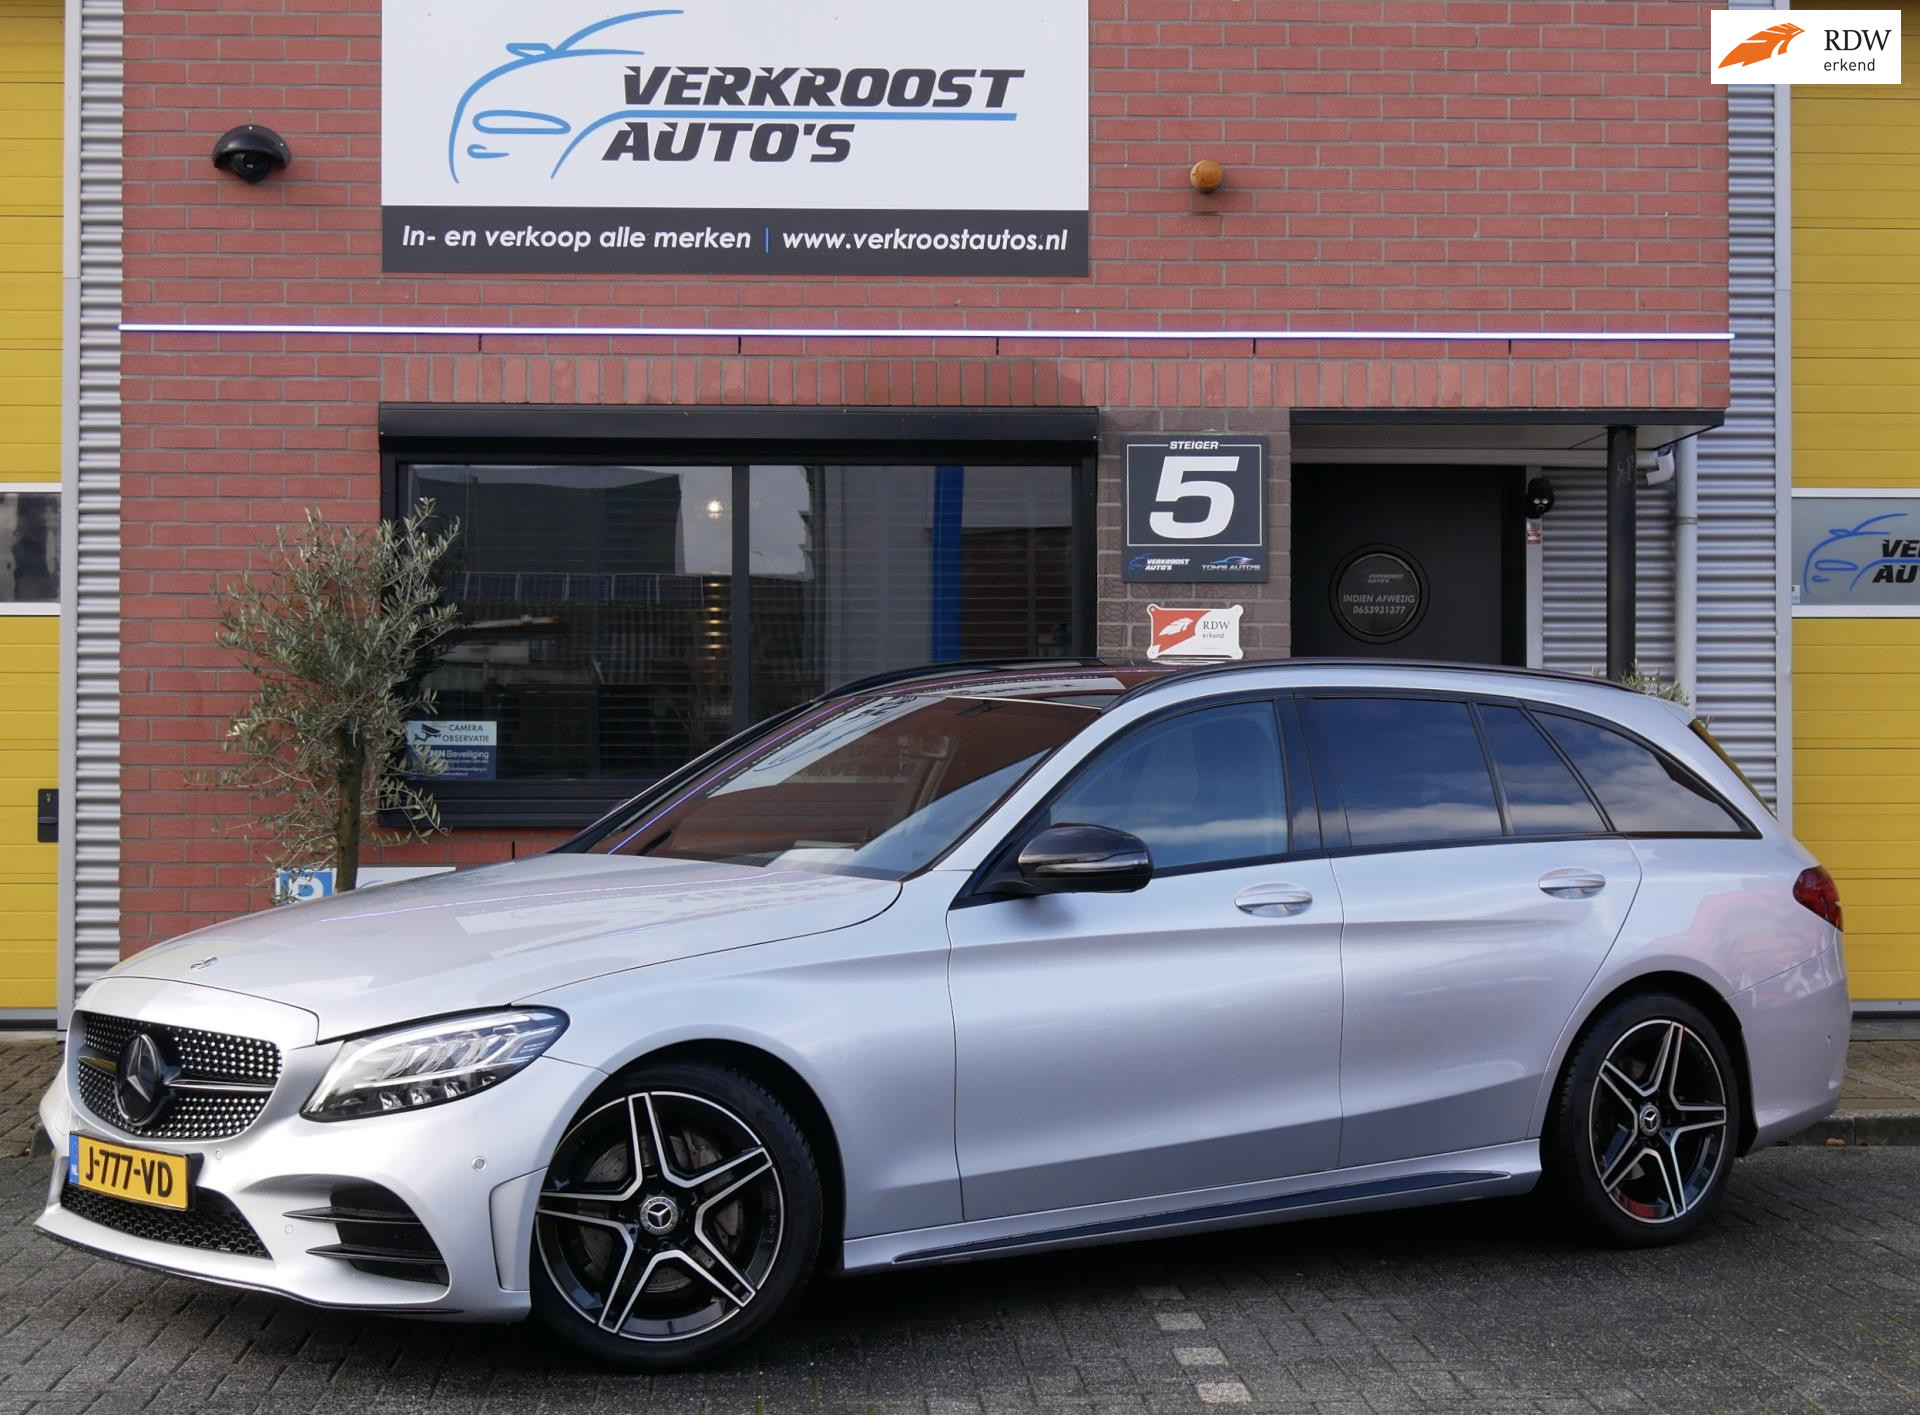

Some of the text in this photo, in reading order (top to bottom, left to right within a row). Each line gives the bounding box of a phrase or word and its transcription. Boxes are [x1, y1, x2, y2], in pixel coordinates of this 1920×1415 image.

[623, 66, 1025, 109] VERKROOST
[601, 122, 855, 163] AUTO'S
[402, 225, 1068, 252] In- en verkoop alle merken www.verkroostautos.nl
[1169, 441, 1219, 450] STEIGER
[1149, 456, 1240, 539] 5
[1881, 539, 1920, 558] VE
[1343, 594, 1415, 604] INDIEN AFWEZIG
[1203, 620, 1230, 630] RDW
[448, 724, 484, 732] CAMERA
[442, 734, 489, 743] OBSERVATIE
[85, 1146, 173, 1198] J-777-VD
